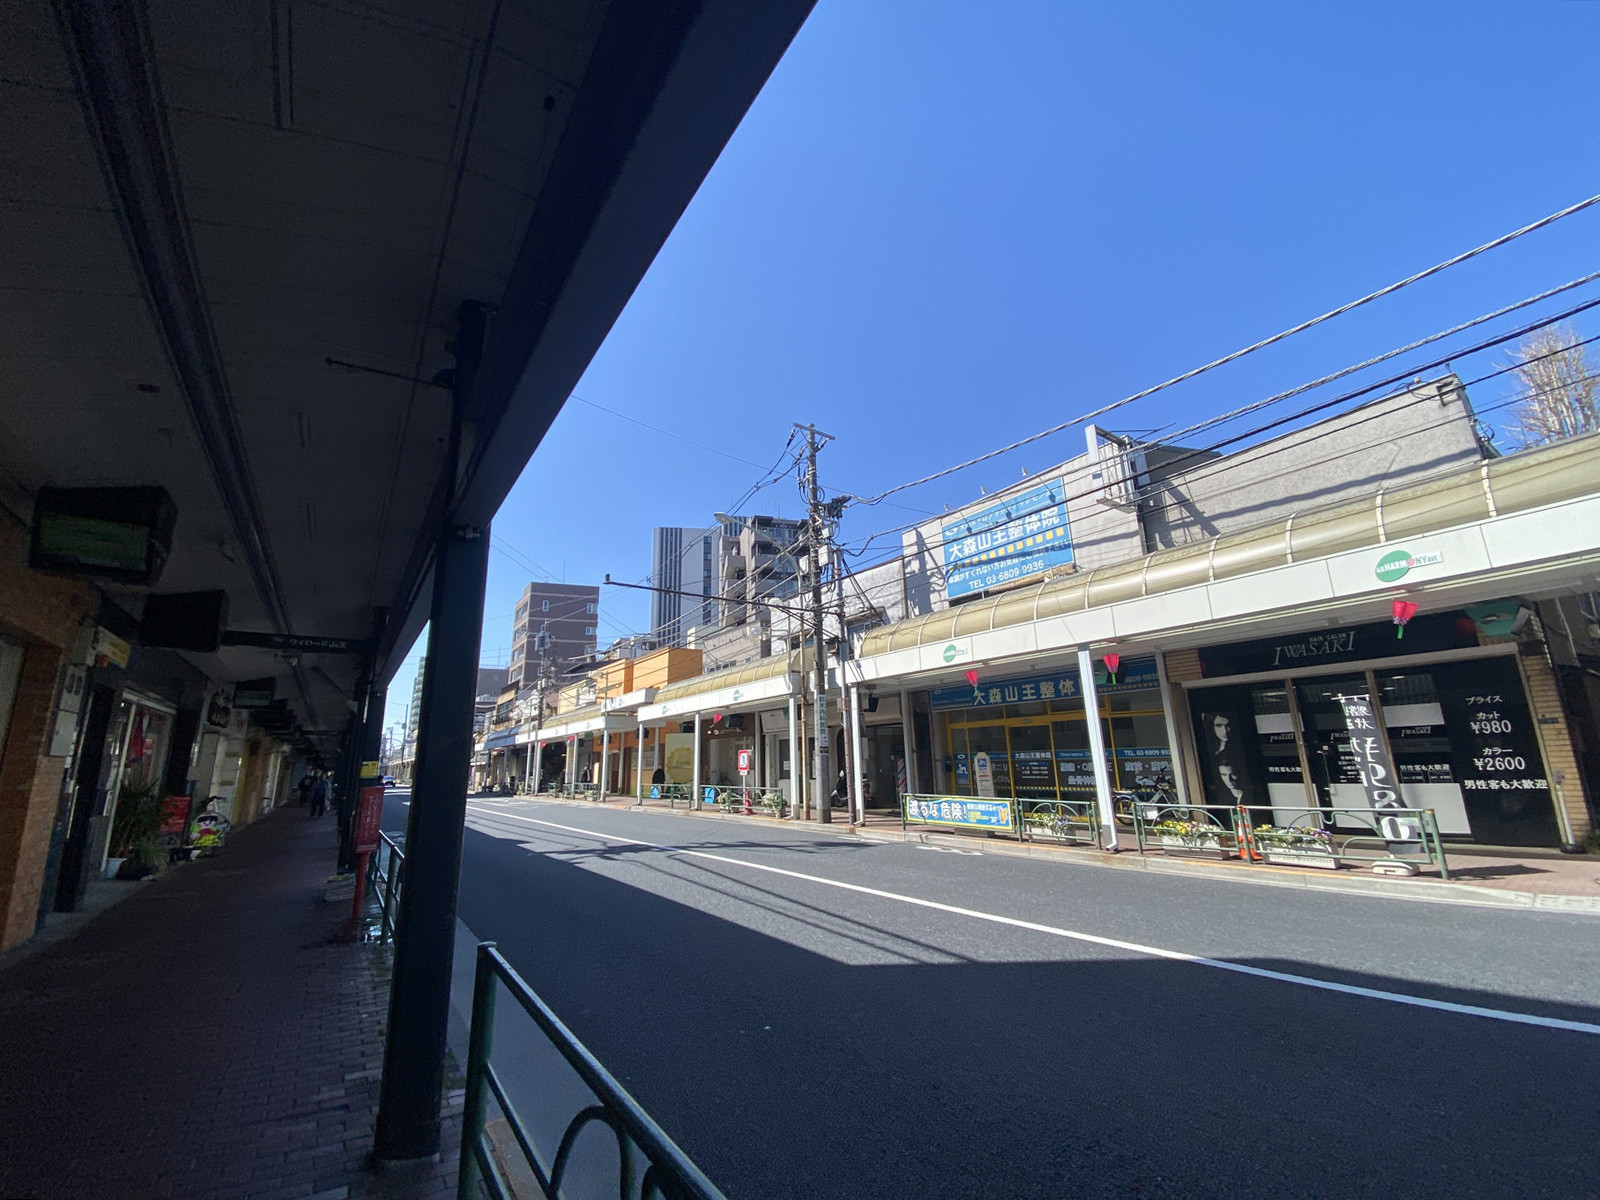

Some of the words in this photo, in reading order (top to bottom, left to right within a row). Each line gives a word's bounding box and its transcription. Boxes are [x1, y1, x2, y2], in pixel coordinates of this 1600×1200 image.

[949, 507, 1060, 561] 大森山王整体院
[969, 578, 985, 590] TEL
[1273, 631, 1357, 666] IWASAKI
[973, 678, 1084, 706] 大森山王整体
[1476, 711, 1500, 721] カット
[1470, 720, 1512, 734] ¥980
[1482, 747, 1513, 756] カラー
[1473, 756, 1525, 771] ¥2600
[1464, 779, 1548, 790] 男性客も大歓迎
